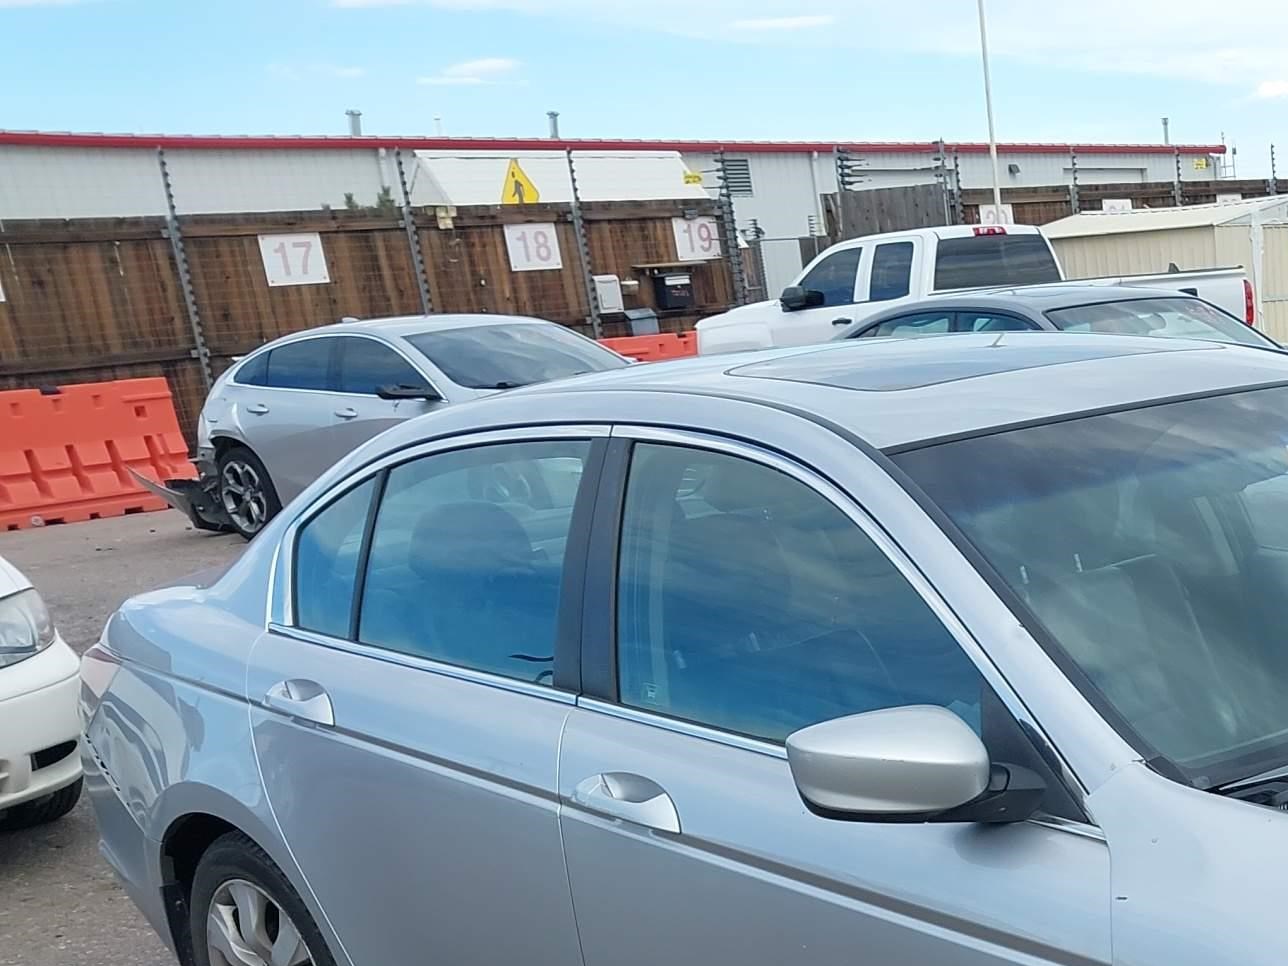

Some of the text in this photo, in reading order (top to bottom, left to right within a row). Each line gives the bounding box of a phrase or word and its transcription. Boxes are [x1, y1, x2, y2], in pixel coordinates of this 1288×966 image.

[515, 230, 552, 263] 18
[683, 222, 713, 252] 19
[273, 241, 313, 277] 17
